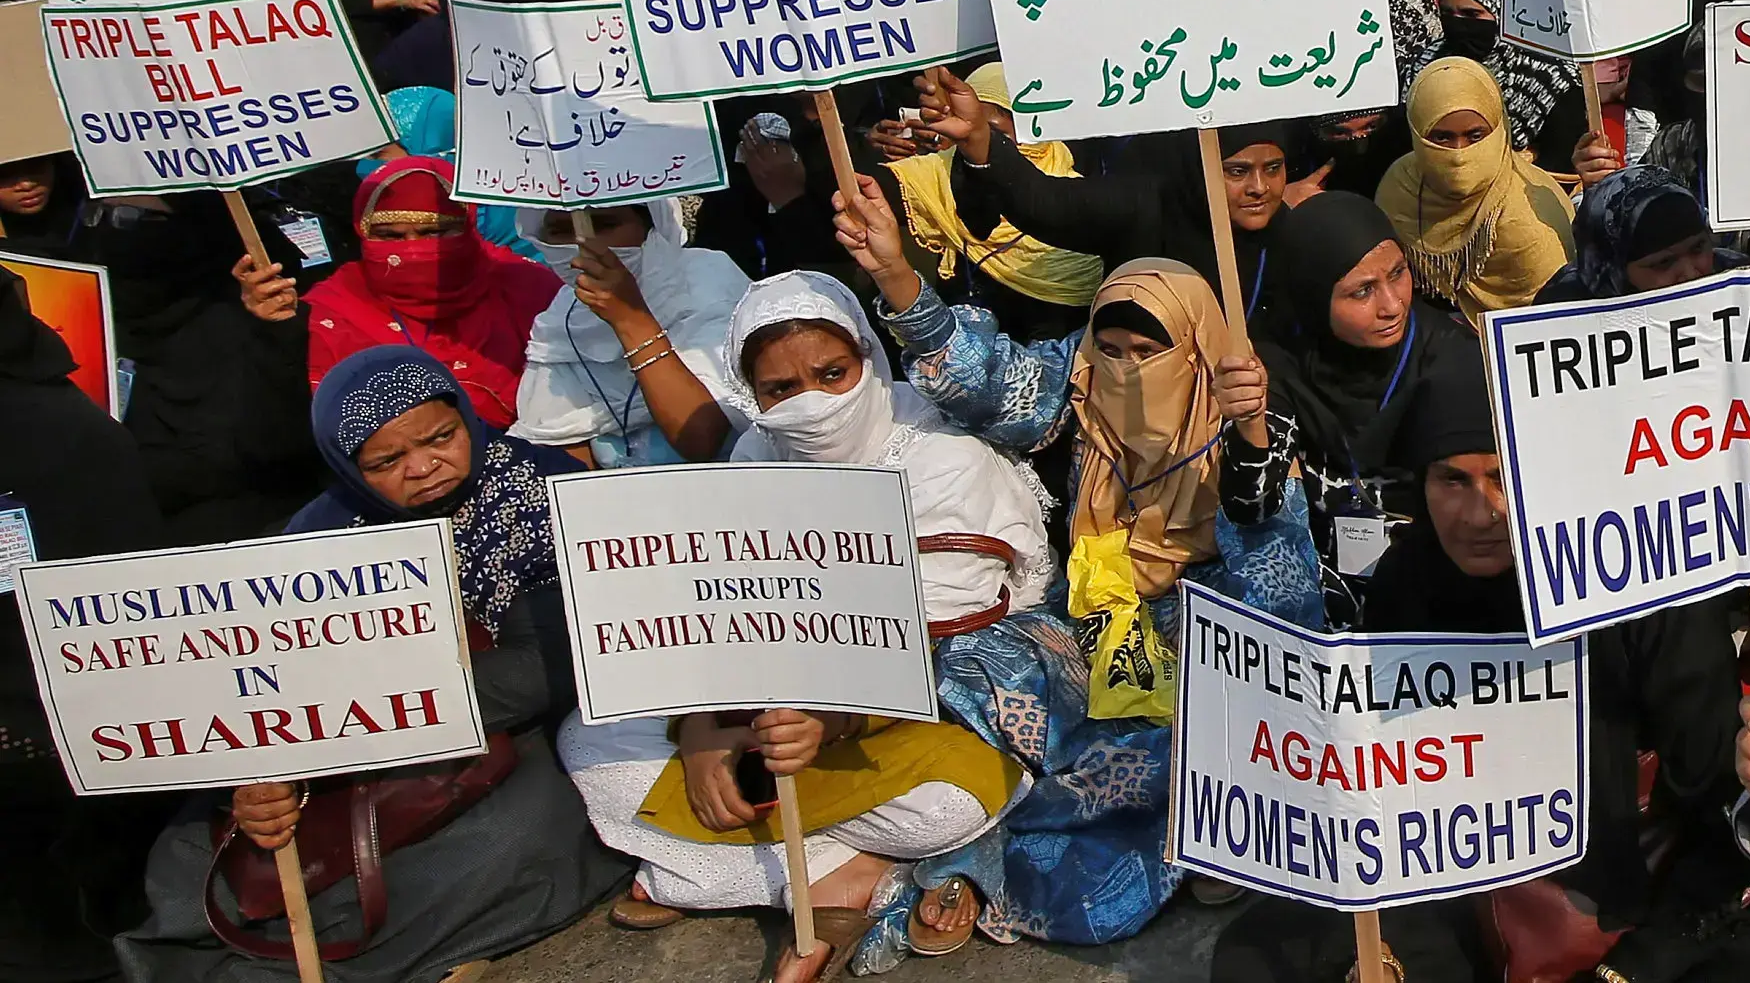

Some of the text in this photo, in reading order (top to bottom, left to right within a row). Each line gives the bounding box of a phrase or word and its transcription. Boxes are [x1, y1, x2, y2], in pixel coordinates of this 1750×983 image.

[51, 17, 173, 60] TRIPLE
[1536, 6, 1572, 36] خلاف
[529, 47, 566, 94] کے
[719, 18, 917, 79] WOMEN
[144, 58, 243, 103] BILL
[1011, 9, 1384, 138] شریعت میں محفوظ ہے
[81, 85, 360, 144] SUPPRESSES
[547, 107, 627, 151] خلاف
[143, 131, 312, 179] WOMEN
[642, 156, 686, 189] تین
[1514, 316, 1700, 399] TRIPLE
[576, 530, 907, 574] TRIPLE TALAQ BILL
[45, 555, 431, 632] MUSLIM WOMEN
[693, 577, 824, 604] DISRUPTS
[59, 602, 439, 676] SAFE AND SECURE
[596, 613, 912, 657] FAMILY AND SOCIETY
[233, 664, 282, 700] IN
[1194, 614, 1304, 697] TRIPLE
[1310, 647, 1459, 715] TALAQ
[1470, 656, 1570, 707] BILL
[89, 688, 447, 764] SHARIAH
[1248, 718, 1487, 794] AGAINST
[1187, 769, 1575, 886] WOMEN'S RIGHTS
